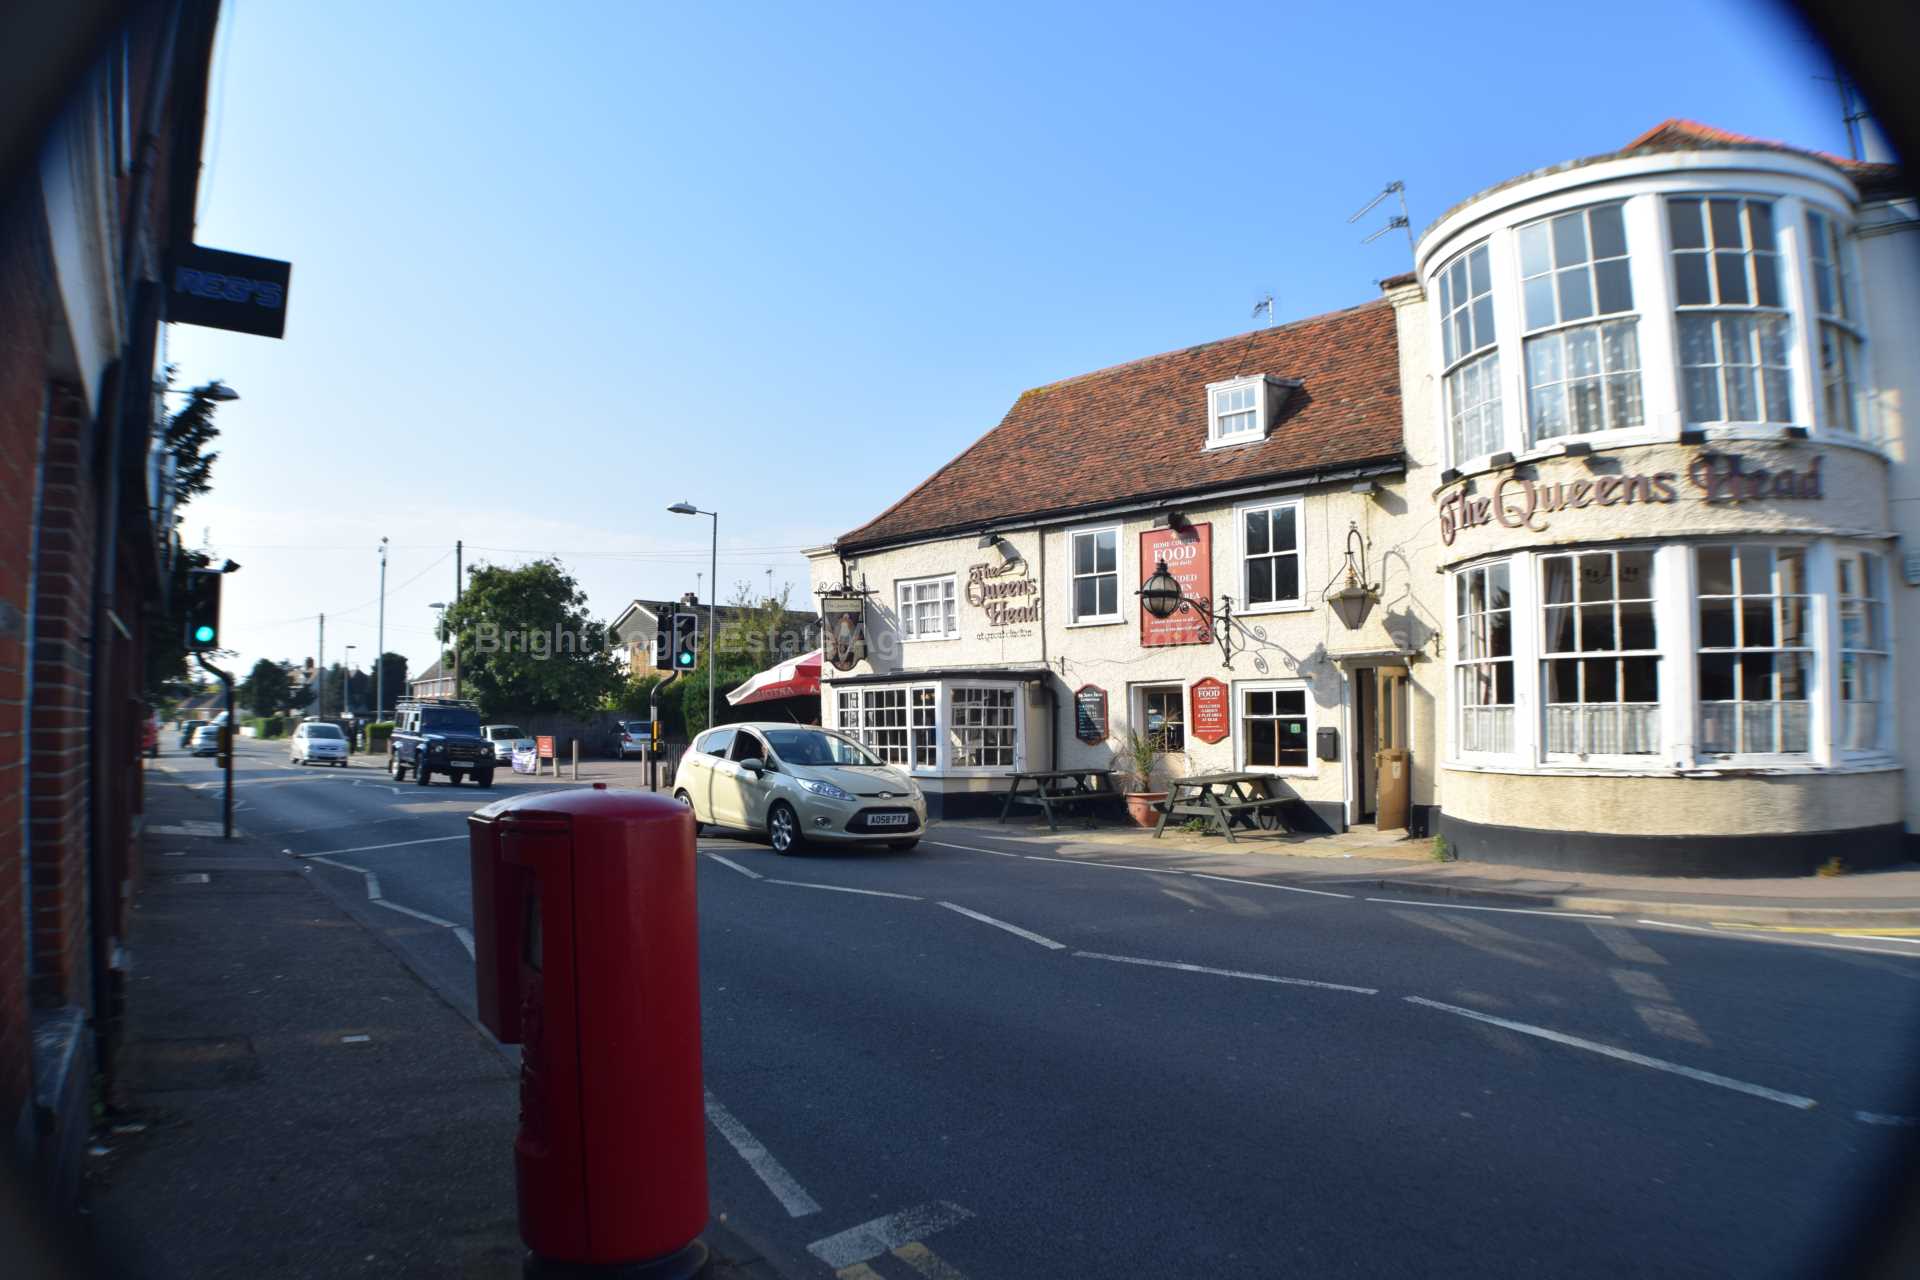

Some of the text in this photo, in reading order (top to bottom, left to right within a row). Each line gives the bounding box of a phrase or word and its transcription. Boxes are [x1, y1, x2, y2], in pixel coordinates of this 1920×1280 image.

[1439, 453, 1823, 546] The Queens Head
[1154, 545, 1196, 563] FOOD
[968, 562, 1008, 583] The
[965, 579, 1037, 607] Queens
[986, 598, 1040, 626] Head
